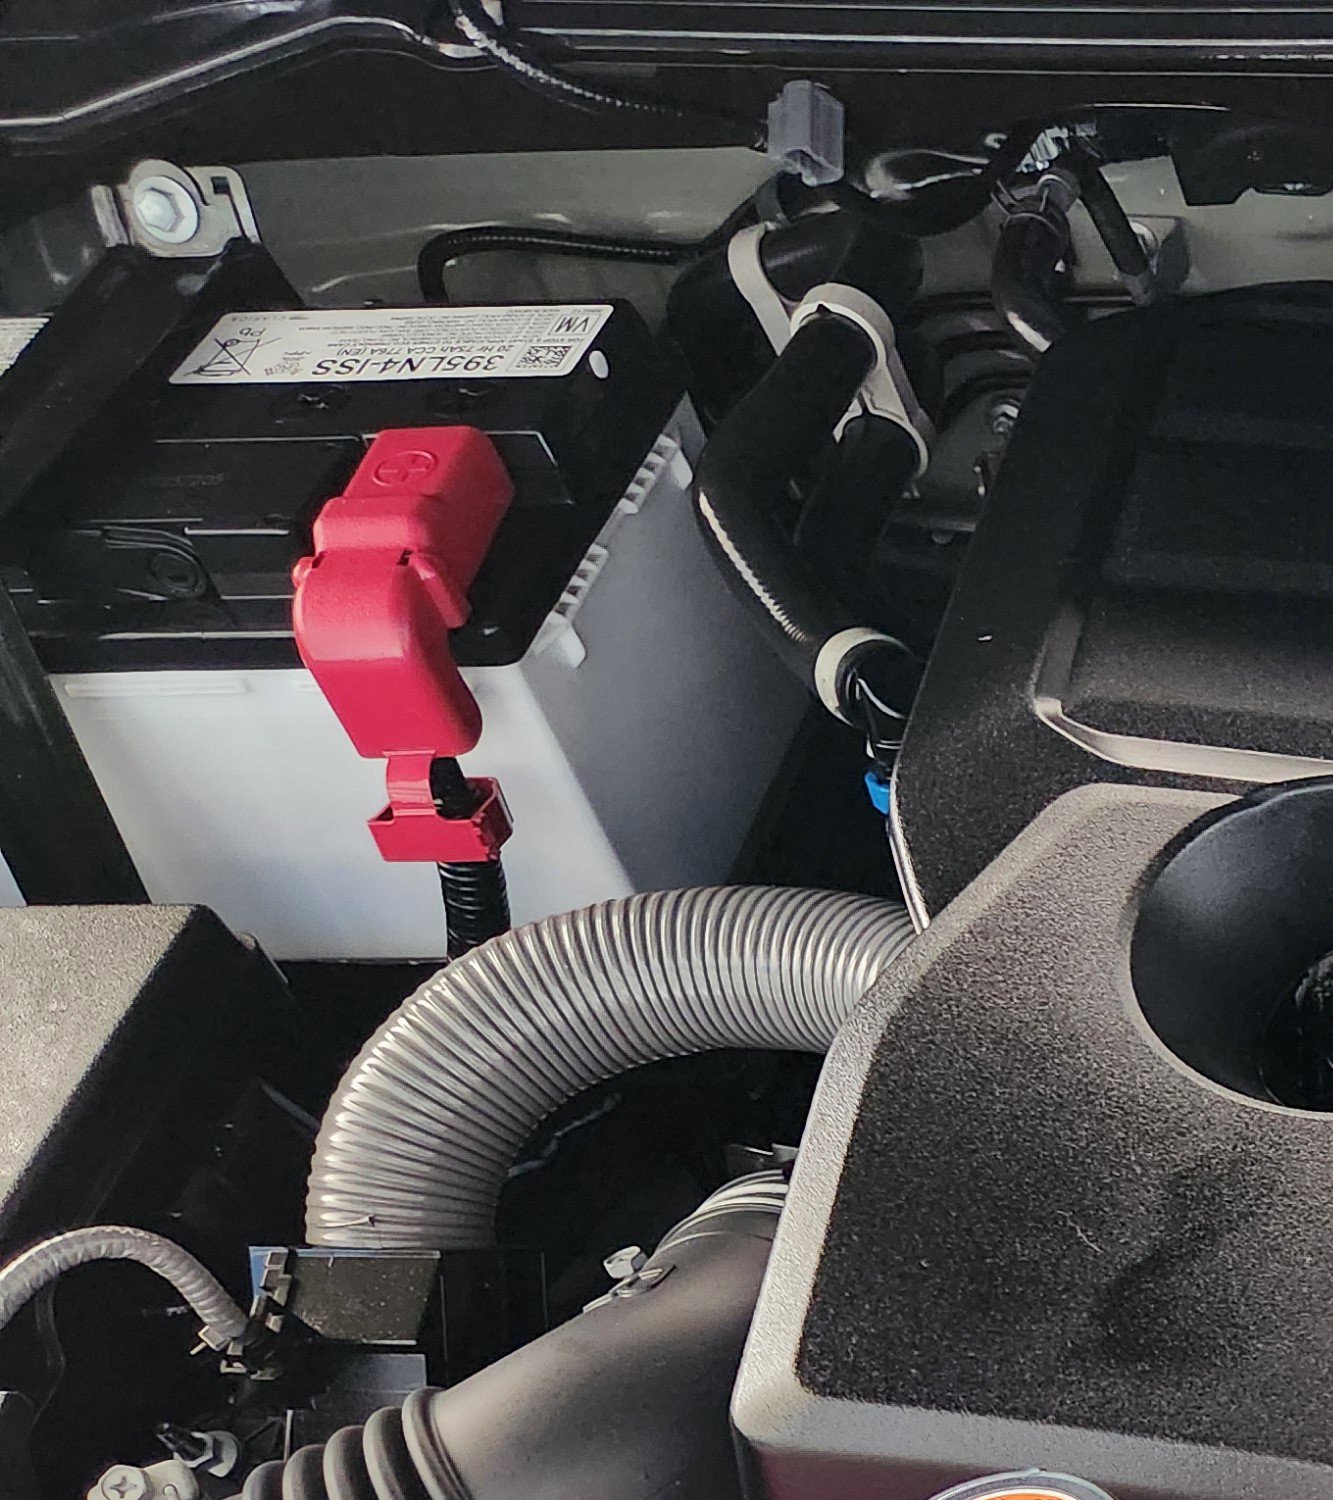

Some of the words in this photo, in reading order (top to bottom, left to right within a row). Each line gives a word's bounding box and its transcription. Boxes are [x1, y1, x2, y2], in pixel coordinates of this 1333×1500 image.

[556, 316, 590, 333] VM
[240, 327, 266, 337] Pb
[336, 348, 367, 356] (EN)
[370, 346, 404, 356] 776A
[407, 346, 437, 354] CCA
[442, 345, 473, 353] 75Ah
[312, 354, 504, 376] 395LN4-ISS
